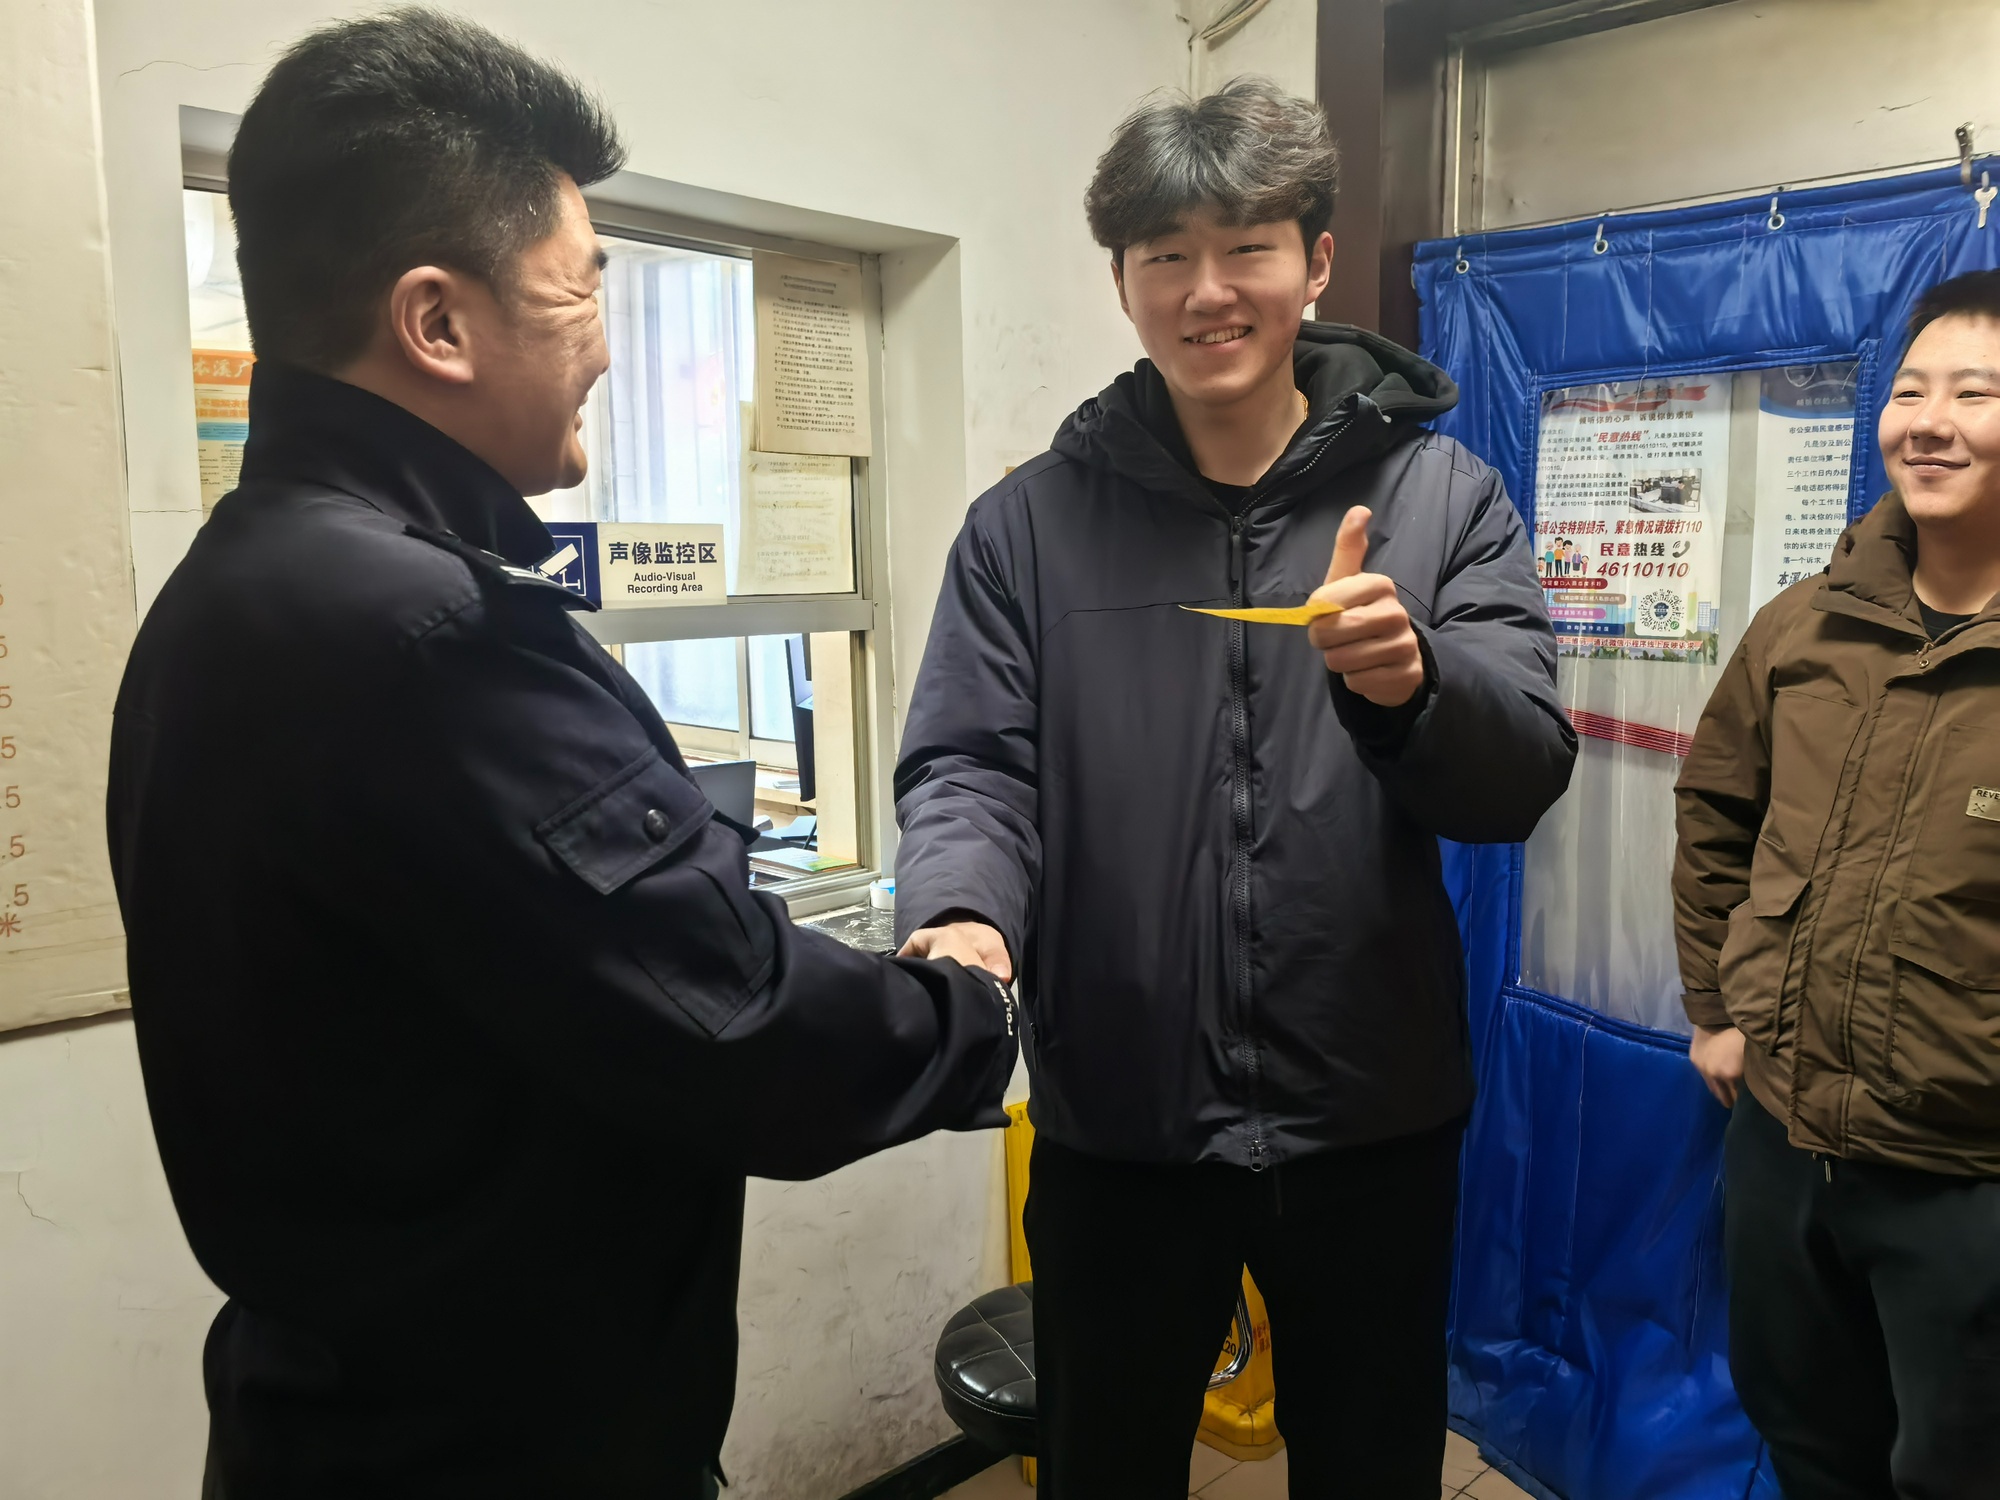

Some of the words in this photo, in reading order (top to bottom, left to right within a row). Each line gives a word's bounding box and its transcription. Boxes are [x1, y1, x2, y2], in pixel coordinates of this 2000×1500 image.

[1579, 414, 1631, 425] 倾听你的心声
[1787, 483, 1848, 492] 一通电话都将得到
[1600, 542, 1665, 557] 民意热线
[1784, 542, 1835, 550] 你的诉求进行
[608, 541, 717, 565] 声像监控区
[1597, 562, 1690, 578] 46110110
[634, 572, 696, 582] Audio-Visual
[627, 583, 678, 595] Recording
[681, 583, 703, 593] Area
[0, 912, 21, 937] 米
